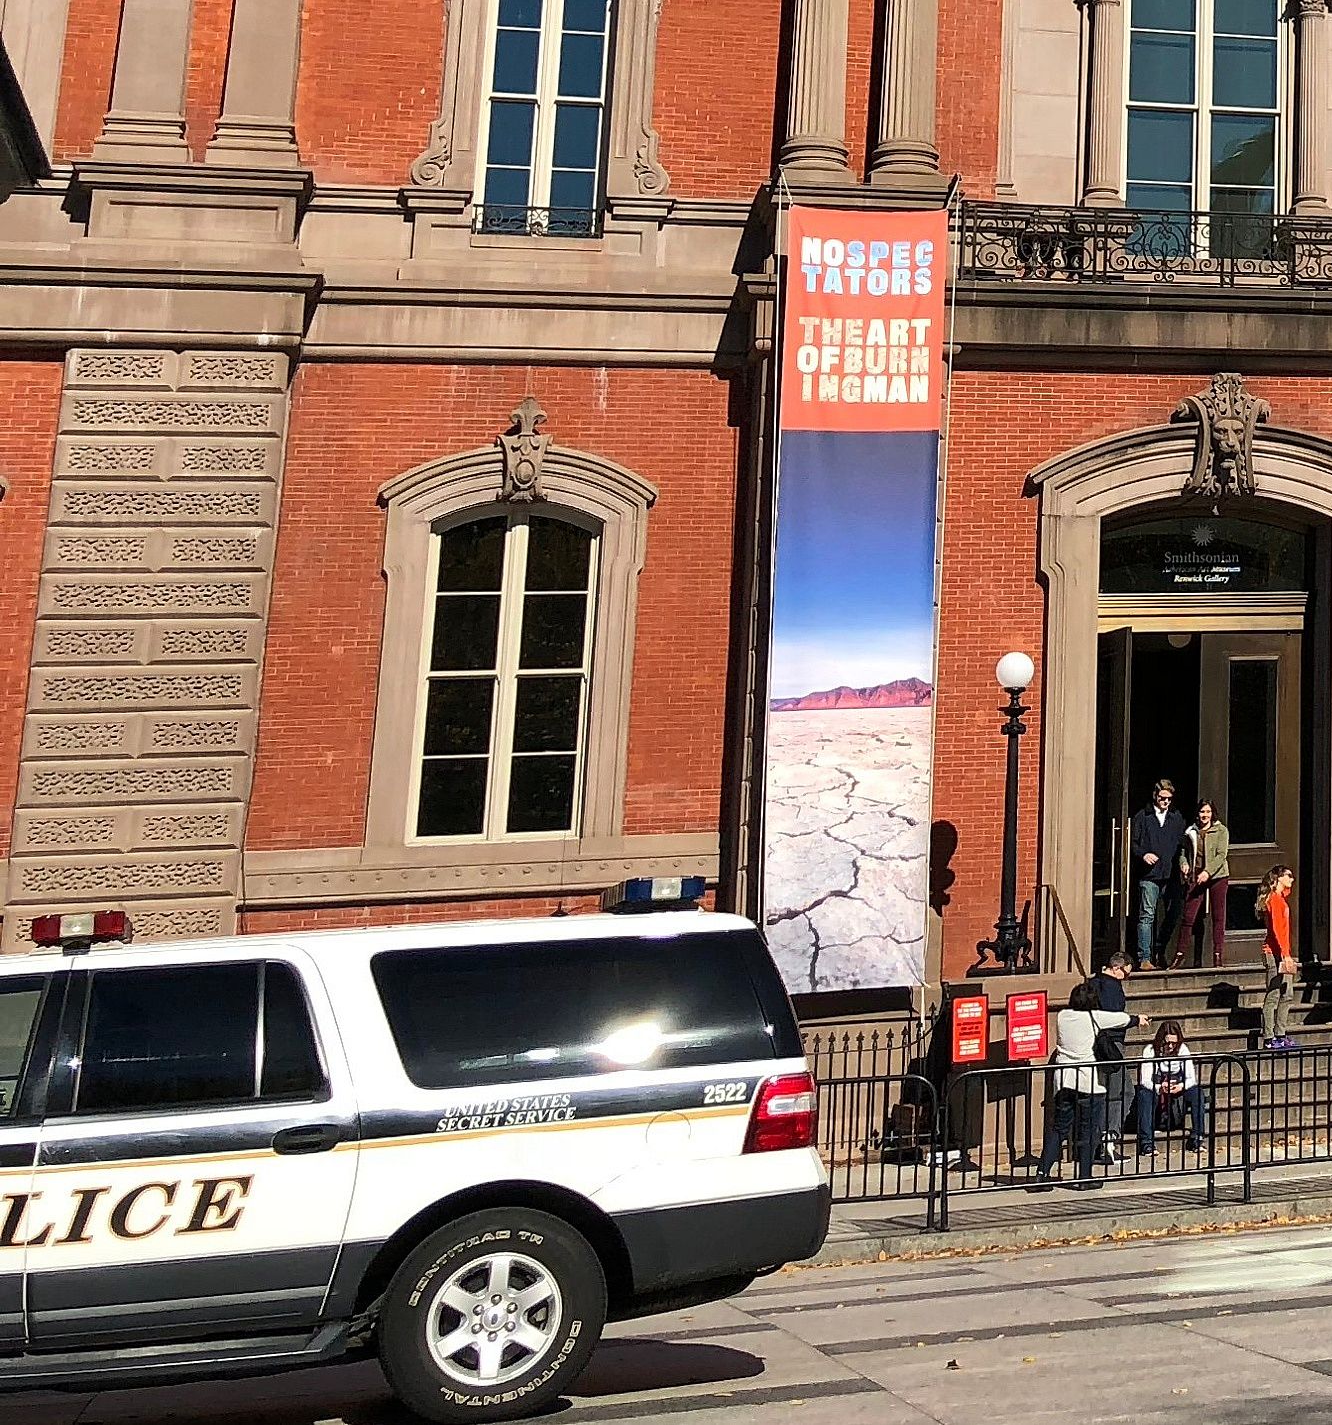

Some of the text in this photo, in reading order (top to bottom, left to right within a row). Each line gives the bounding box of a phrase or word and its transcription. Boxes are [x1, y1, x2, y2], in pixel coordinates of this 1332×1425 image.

[801, 264, 933, 296] TATORS
[1164, 551, 1240, 564] Smithsonian
[1203, 574, 1230, 585] Gallery
[703, 1082, 747, 1104] 2522
[444, 1094, 571, 1118] UNITED STATES
[436, 1106, 577, 1132] SECRET SERVICE
